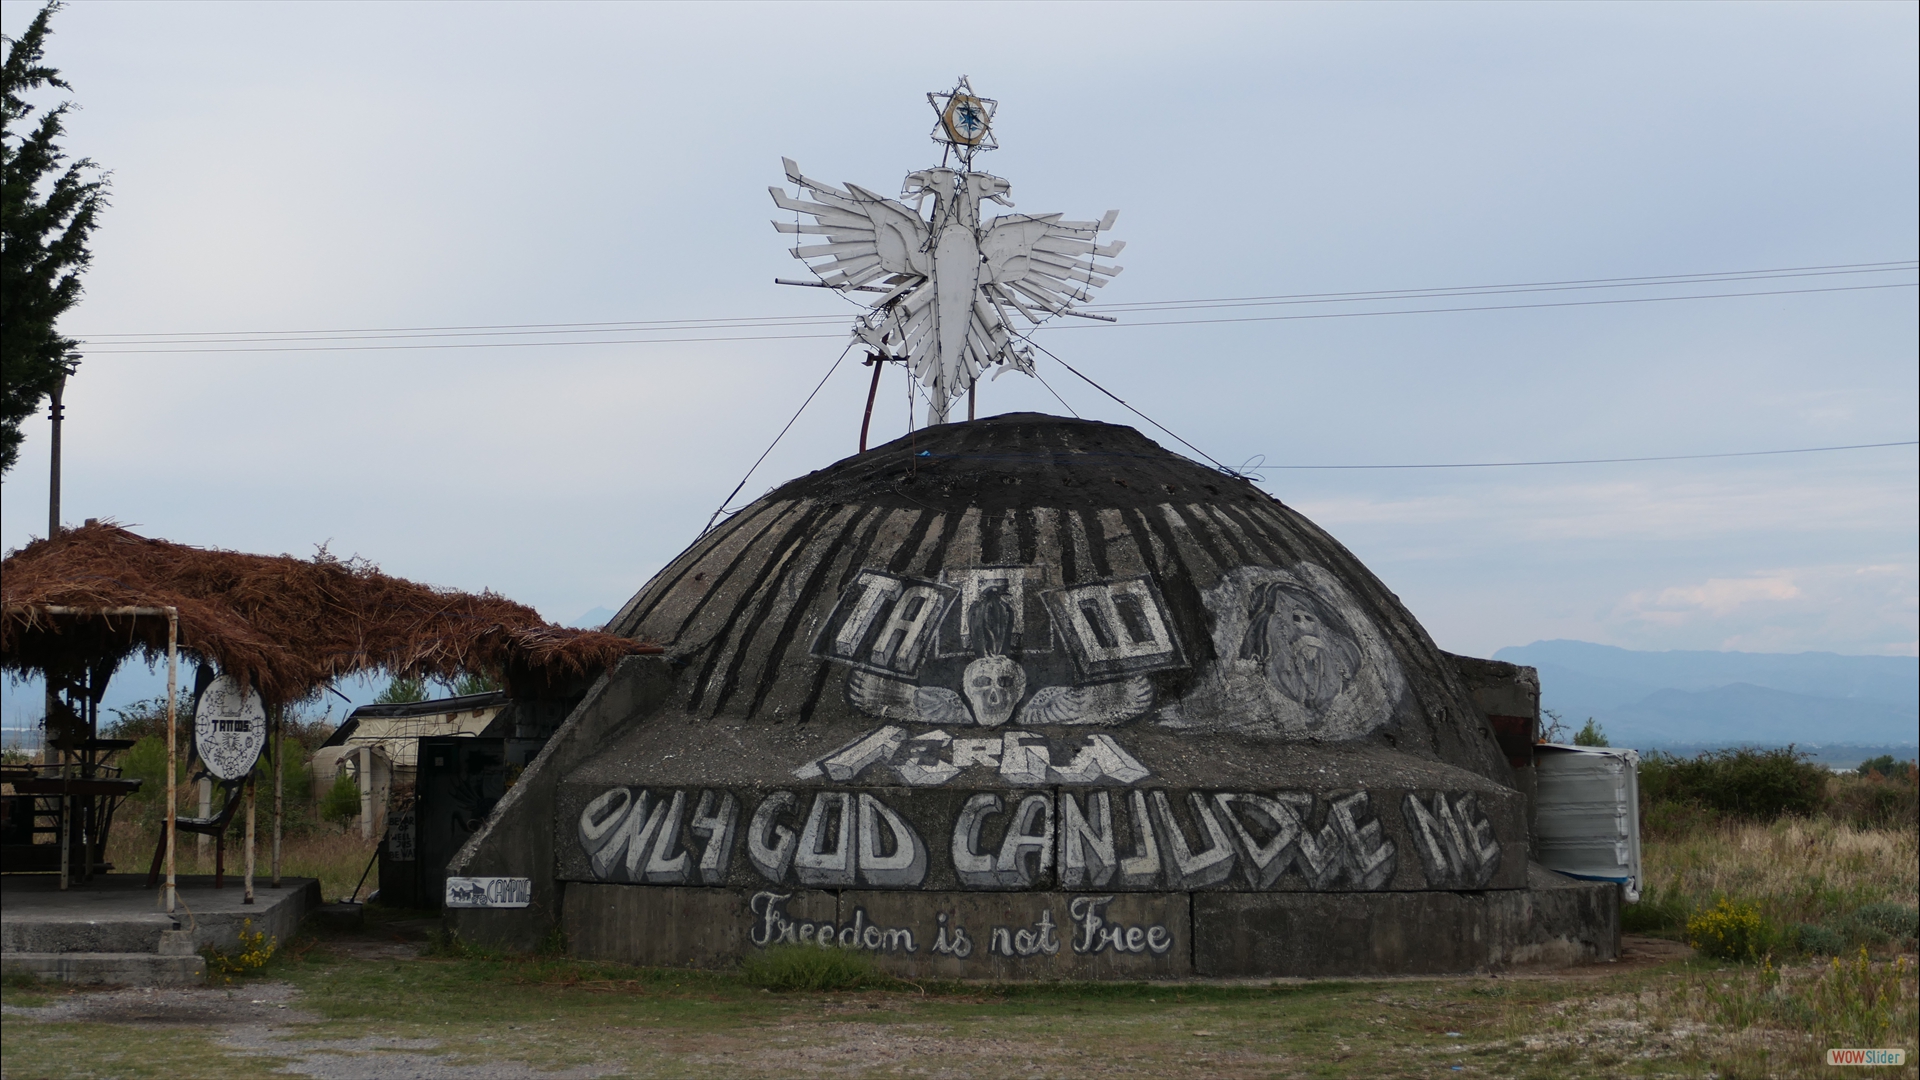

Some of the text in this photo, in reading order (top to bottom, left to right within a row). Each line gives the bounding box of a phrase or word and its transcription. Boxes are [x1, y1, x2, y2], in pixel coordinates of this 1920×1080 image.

[578, 785, 1500, 890] ONLY GOD CAN JUDGE ME
[486, 878, 531, 904] CAMPING
[749, 890, 1171, 957] Freedom is not Free
